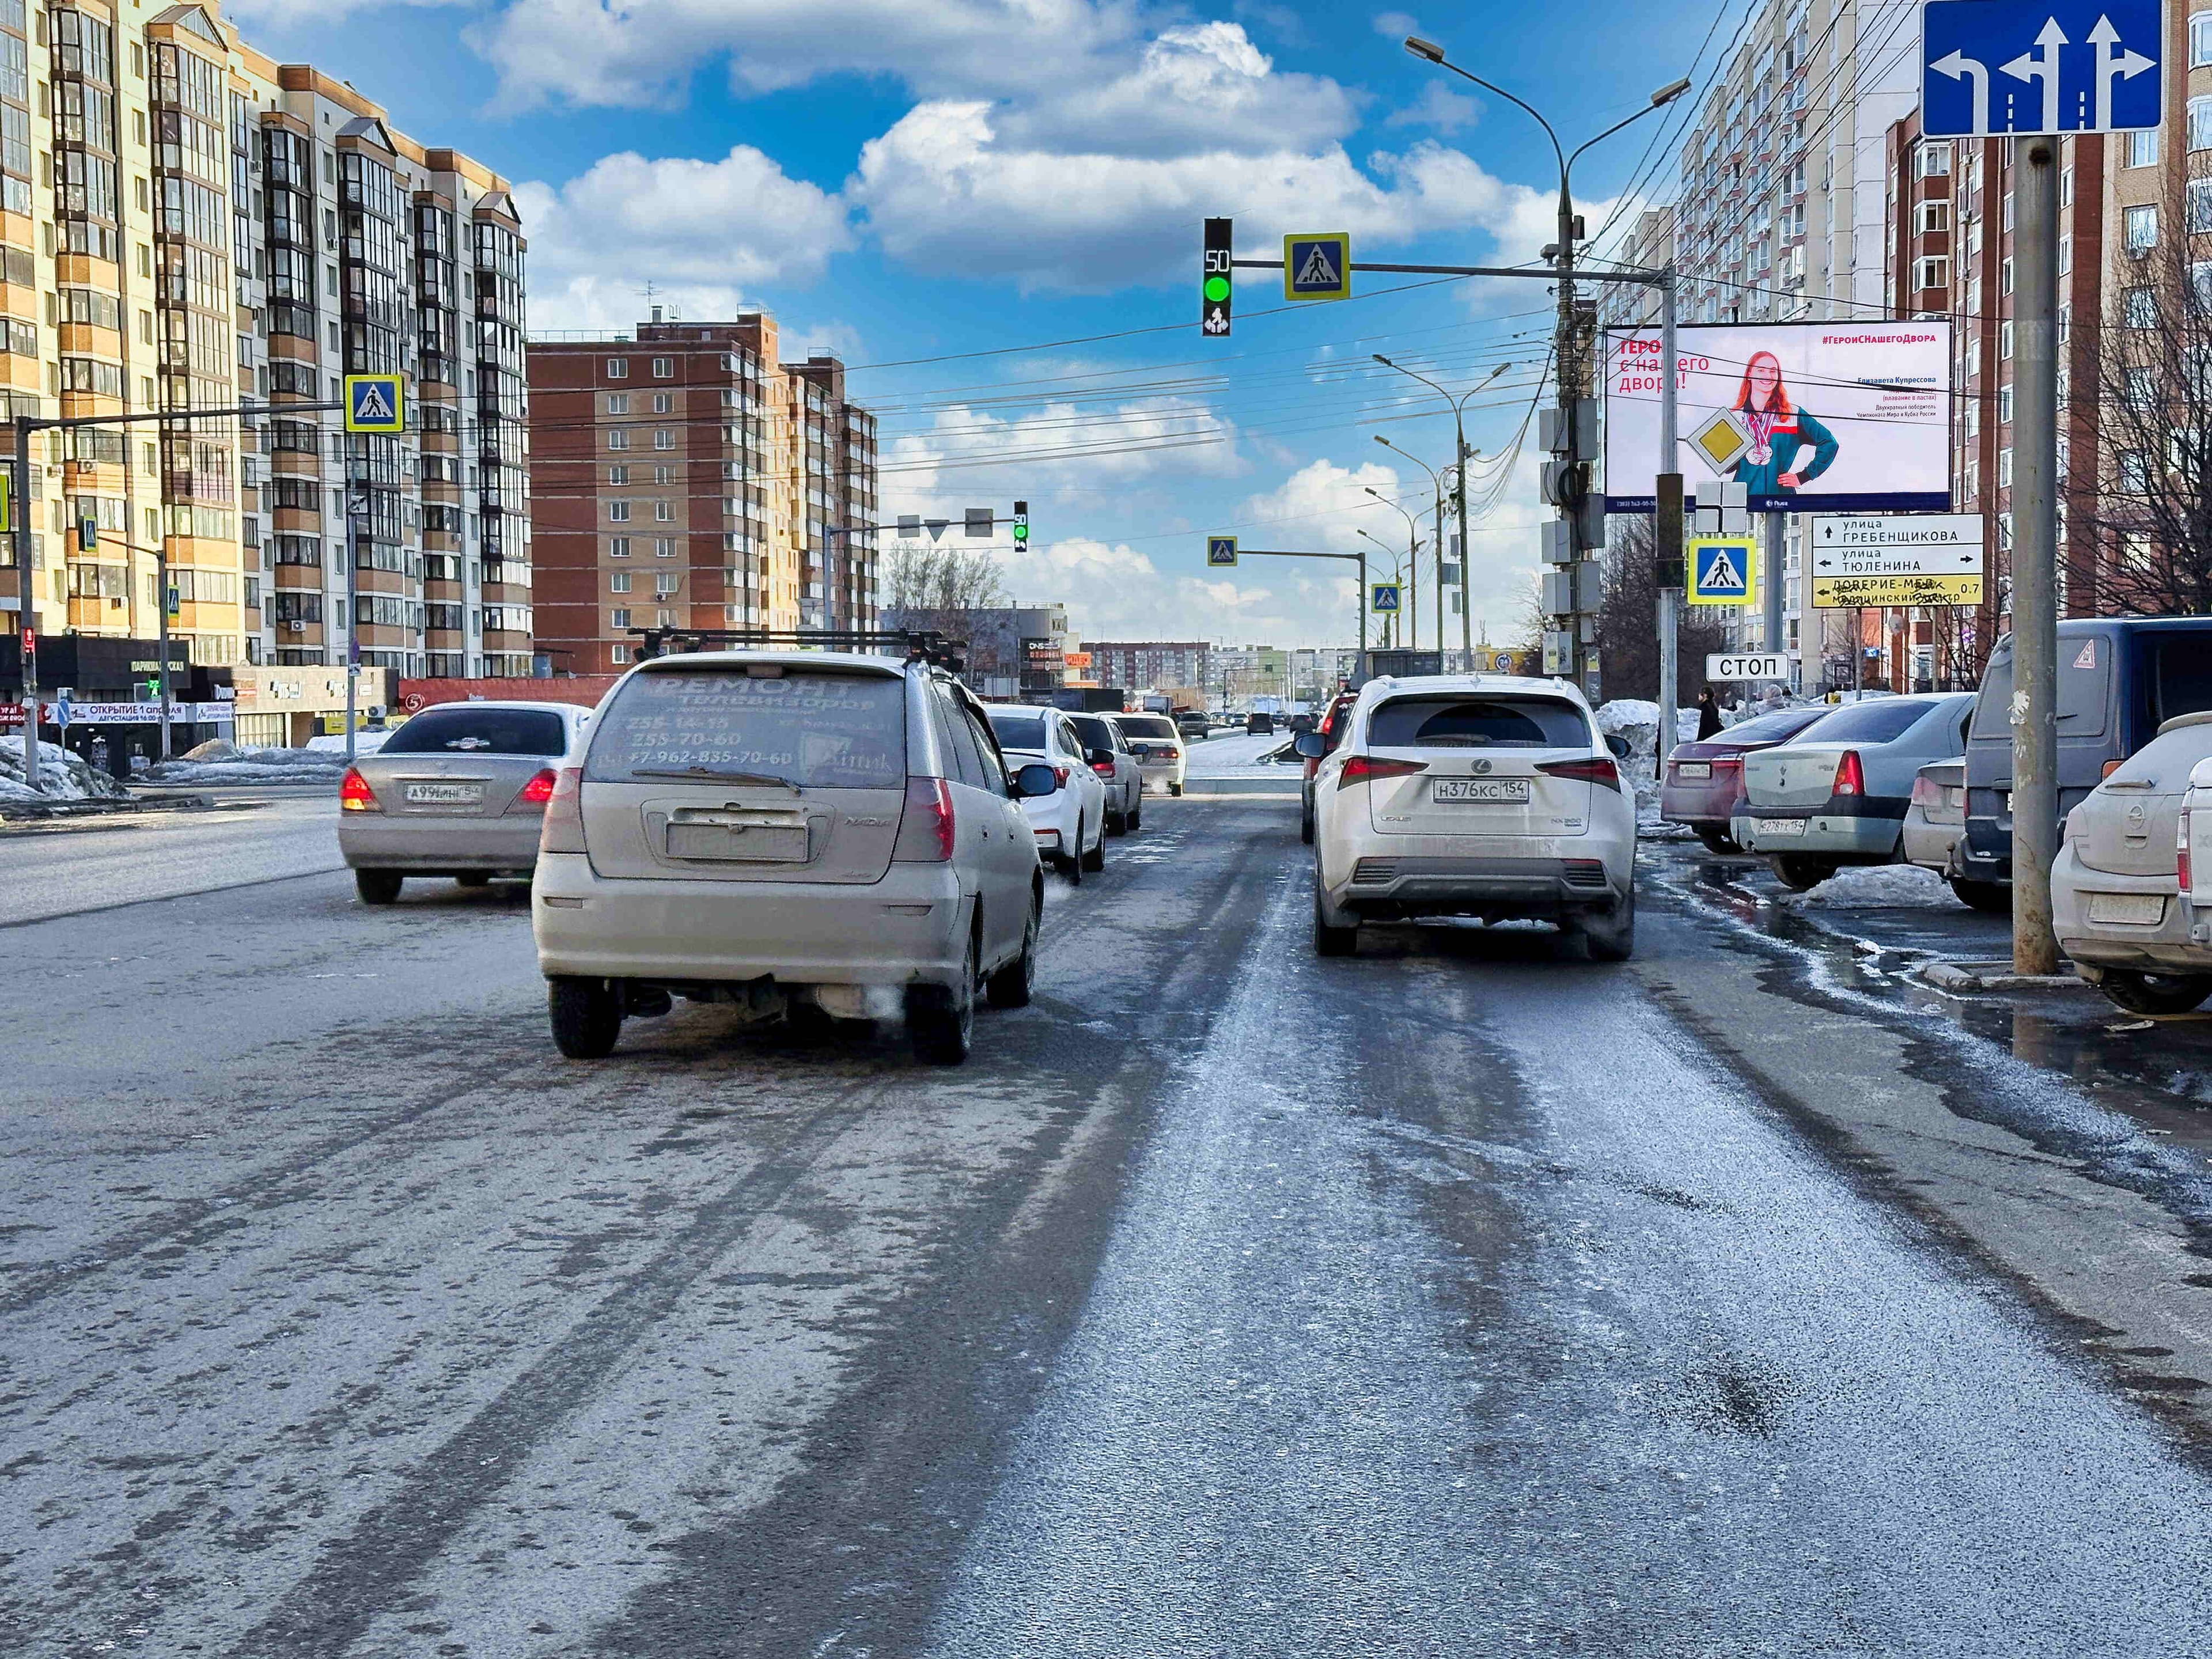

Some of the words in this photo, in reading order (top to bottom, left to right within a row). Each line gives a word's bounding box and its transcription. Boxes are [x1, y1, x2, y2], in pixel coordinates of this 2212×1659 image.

[1206, 250, 1230, 272] 50
[1620, 340, 1663, 354] ГЕРО
[1637, 358, 1709, 372] наего
[1895, 376, 1936, 384] Купрессова
[1843, 520, 1882, 531] улица
[1843, 531, 1958, 543] ГРЕБЕНЩИКОВА
[1842, 550, 1881, 560] улица
[1842, 560, 1921, 572] ТЮЛЕНИНА
[1960, 584, 1979, 594] 0.7
[1719, 658, 1777, 676] СТОП
[656, 679, 859, 696] РЕМОНТ
[90, 705, 138, 714] ОТКРЫТИЕ
[139, 706, 144, 714] 1
[146, 707, 182, 715] апрля
[1440, 782, 1498, 797] Н376КС
[1502, 782, 1524, 793] 154
